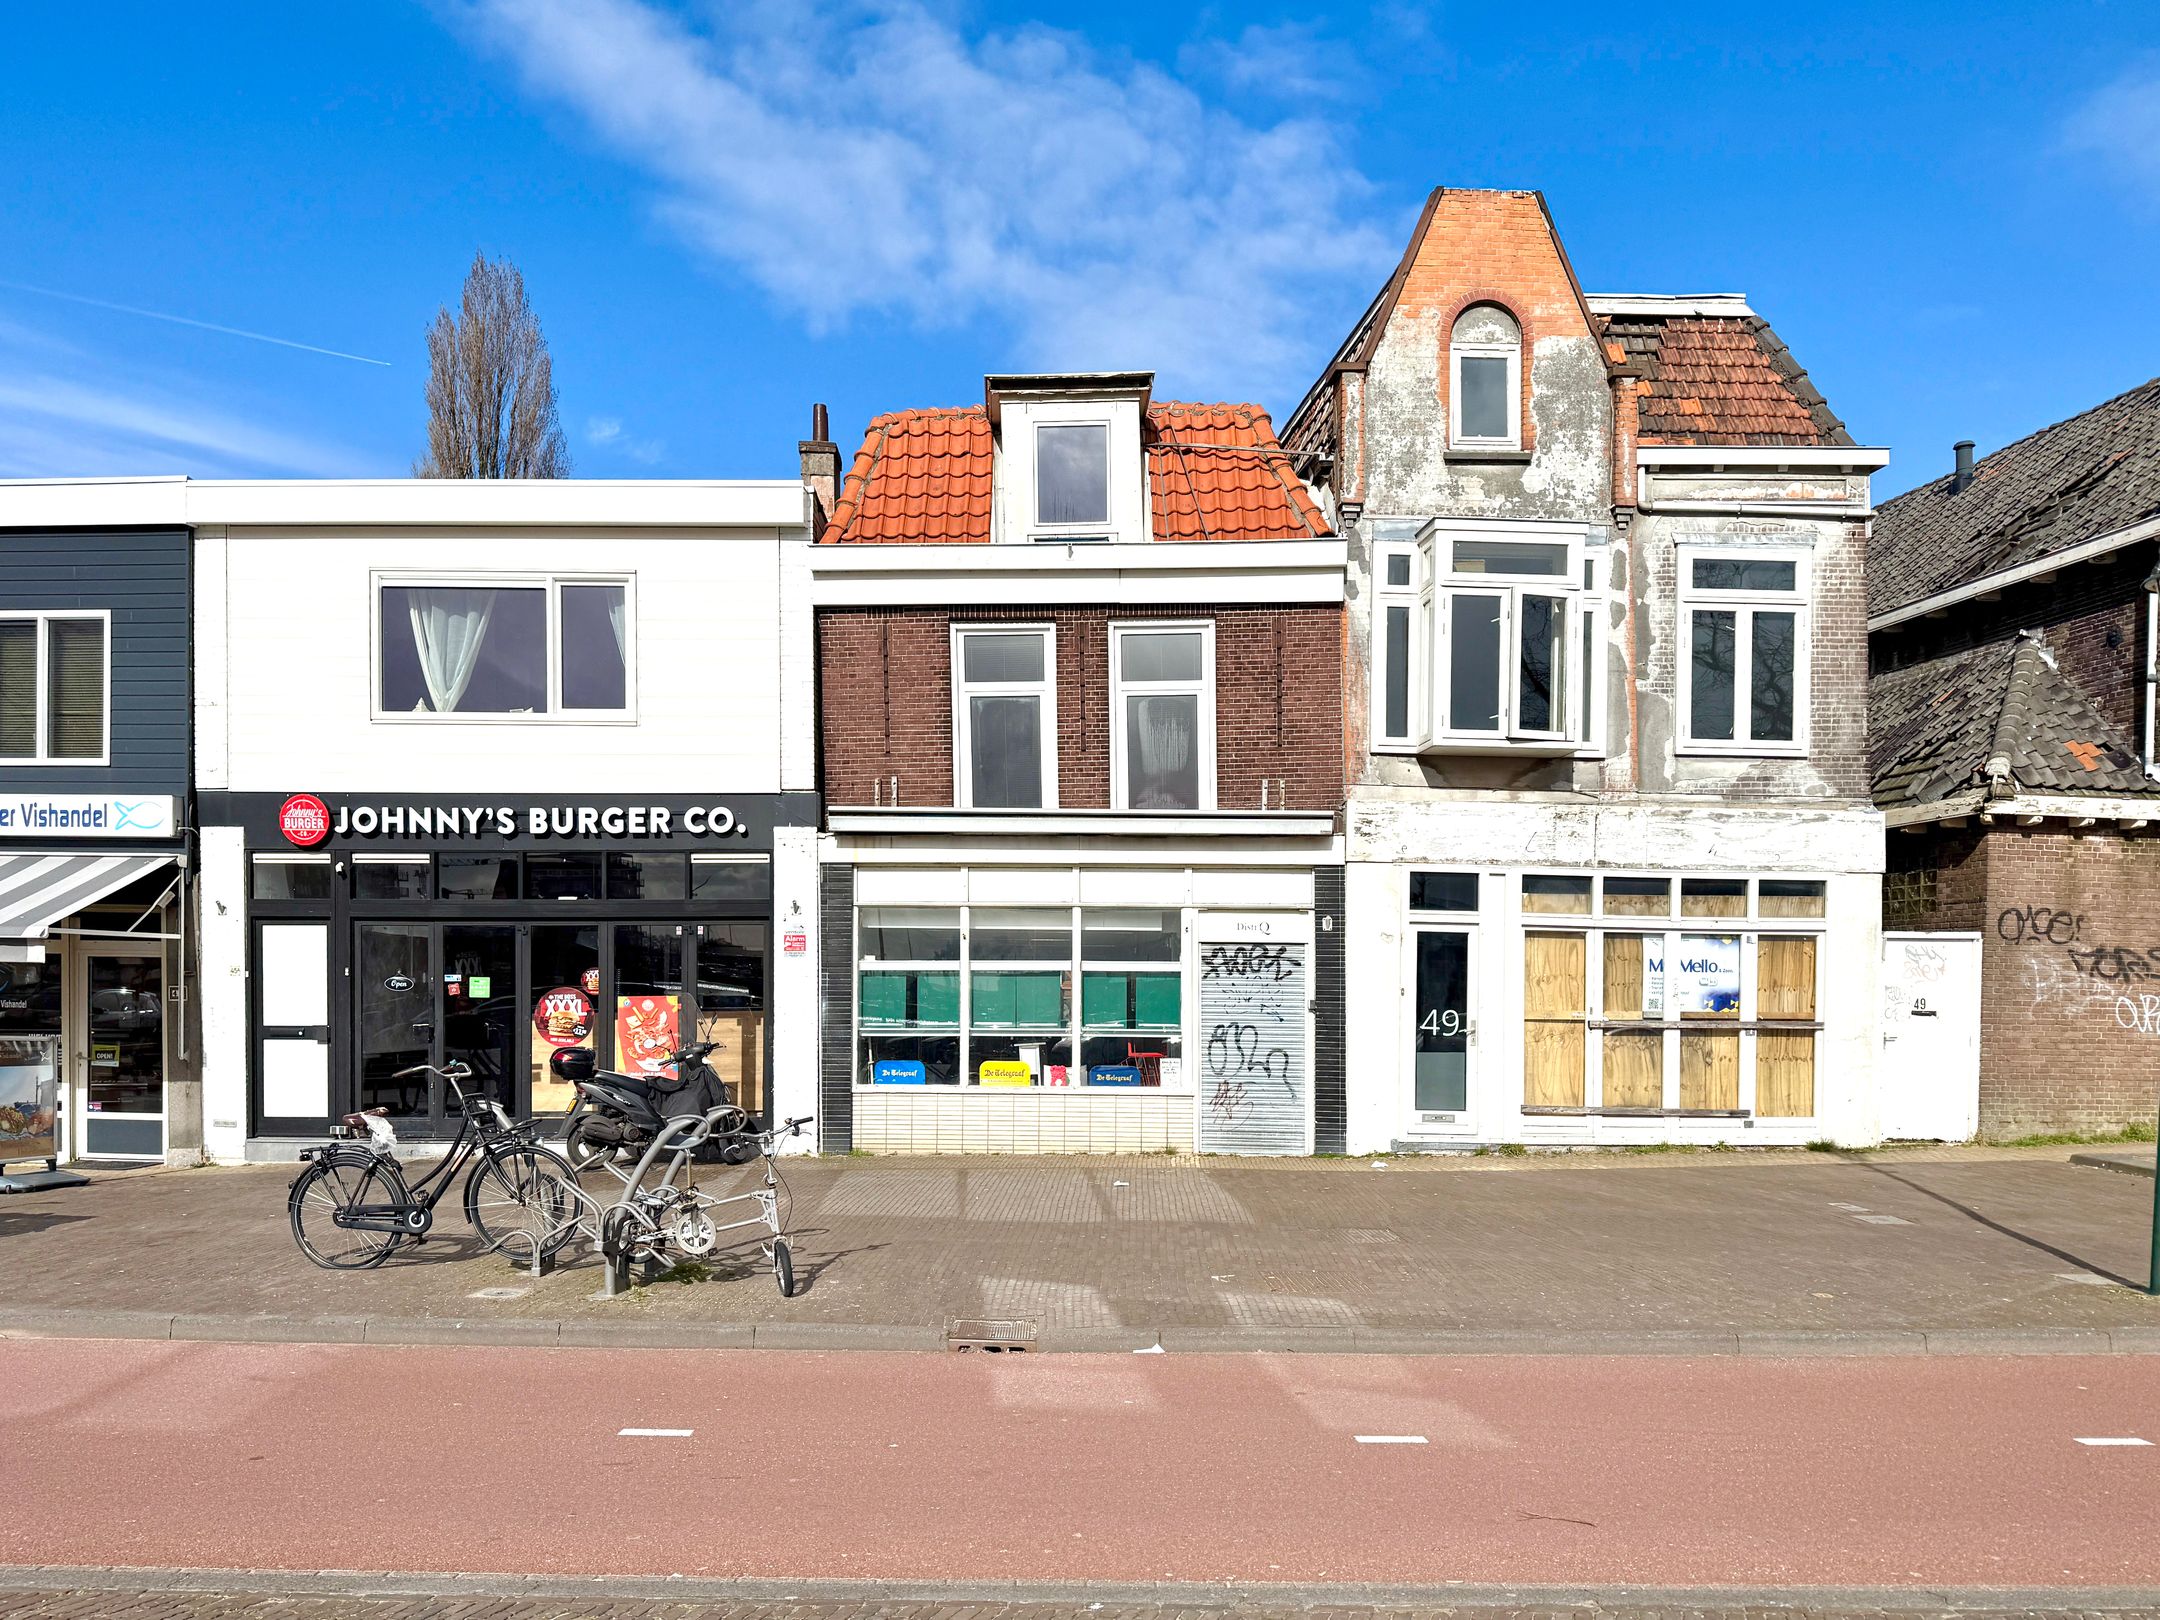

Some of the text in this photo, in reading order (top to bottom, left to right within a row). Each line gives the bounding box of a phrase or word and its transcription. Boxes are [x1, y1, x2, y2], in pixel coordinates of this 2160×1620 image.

[20, 802, 108, 828] Vishandel
[286, 804, 323, 818] Johnny's
[284, 817, 325, 829] BURGER
[335, 806, 747, 834] JOHNNY'S BURGER CO.
[390, 979, 408, 989] Open
[1, 999, 28, 1009] Vishandel
[544, 998, 588, 1017] XXXL
[1913, 997, 1927, 1010] 49
[1419, 1009, 1460, 1037] 49
[96, 1052, 113, 1060] OPEN!
[882, 1068, 919, 1078] De Telegraaf
[984, 1069, 1026, 1079] De Telegraaf
[1105, 1074, 1134, 1082] Telegraaf
